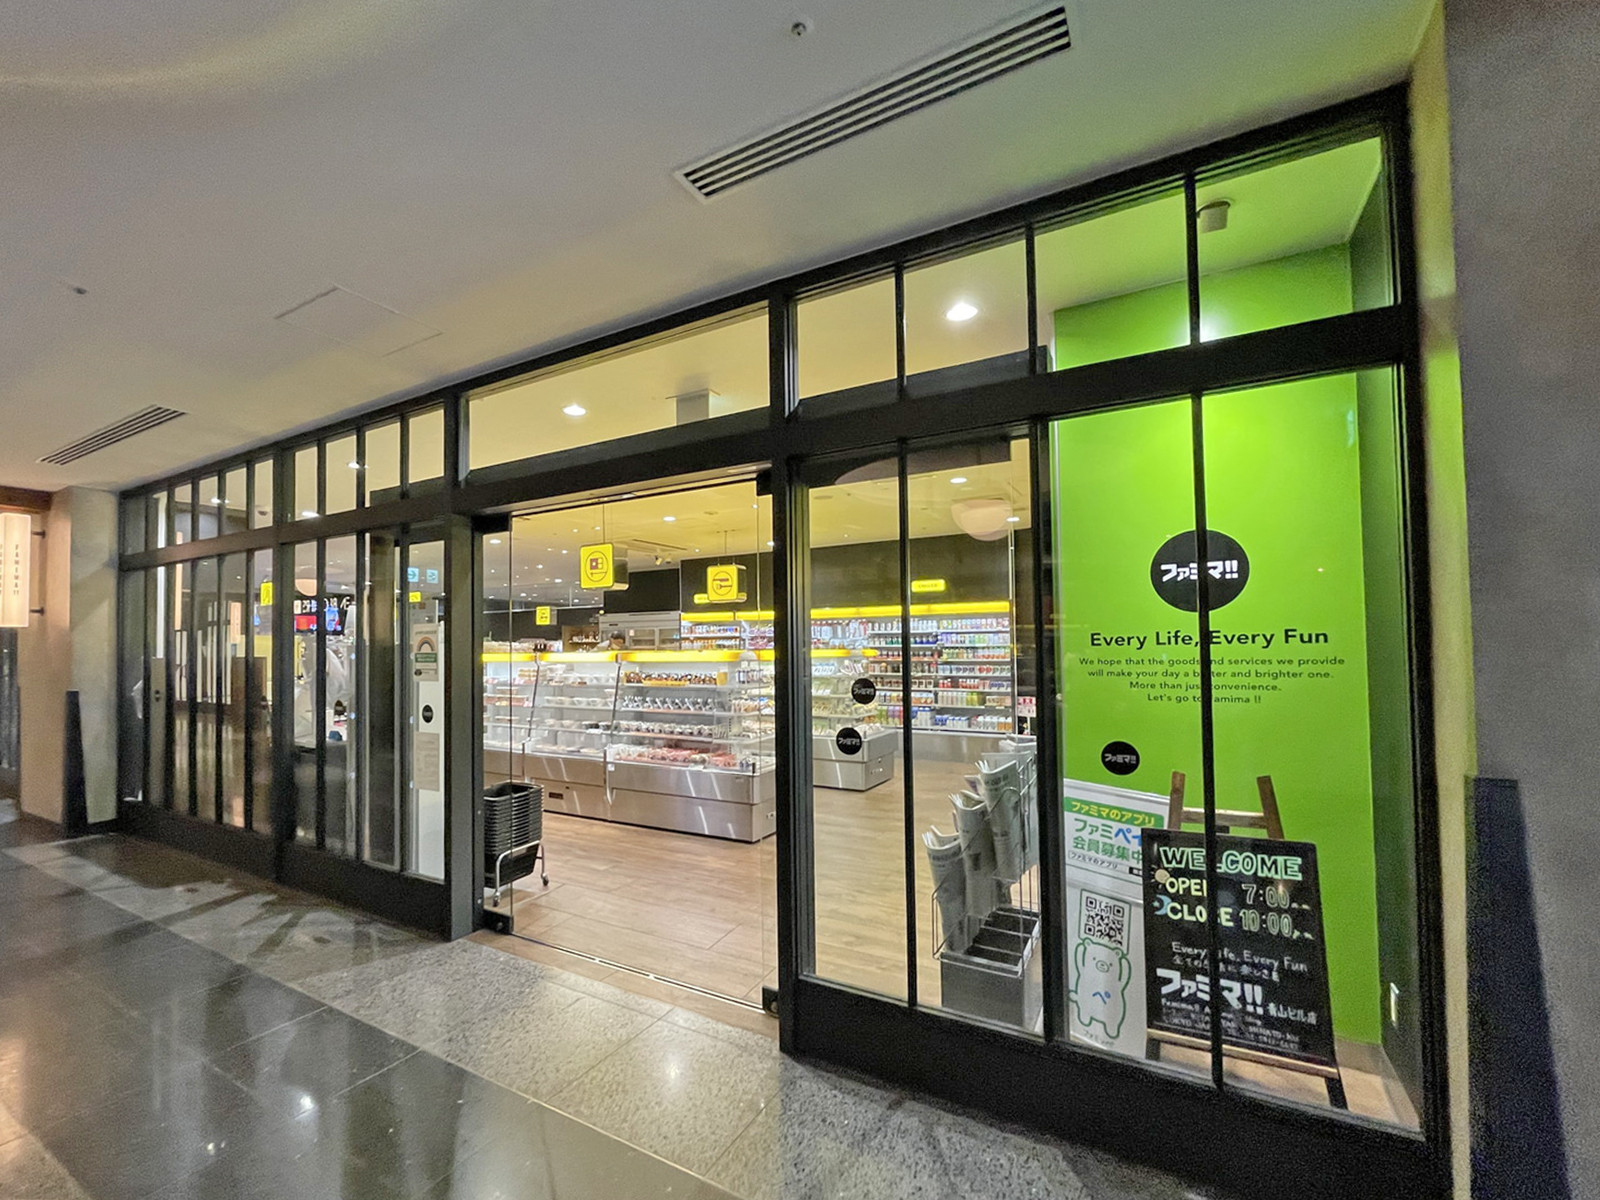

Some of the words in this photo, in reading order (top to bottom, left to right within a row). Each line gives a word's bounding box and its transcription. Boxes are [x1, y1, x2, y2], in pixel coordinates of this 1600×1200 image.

[1090, 631, 1147, 650] Every
[1155, 629, 1200, 648] Life,
[1209, 629, 1275, 649] Every
[1284, 628, 1328, 644] Fun
[1079, 657, 1095, 665] We
[1097, 657, 1122, 667] hope
[1125, 657, 1145, 665] that
[1148, 657, 1165, 665] the
[1167, 656, 1200, 667] goods
[1210, 656, 1224, 665] nd
[1228, 656, 1273, 666] services
[1297, 656, 1345, 668] provide
[1088, 669, 1104, 677] will
[1106, 669, 1133, 677] make
[1136, 670, 1158, 679] your
[1161, 669, 1180, 679] day
[1193, 668, 1227, 678] bter
[1230, 669, 1252, 678] and
[1255, 669, 1304, 681] brighter
[1307, 671, 1334, 679] one.
[1129, 681, 1156, 690] More
[1160, 681, 1183, 690] than
[1185, 681, 1200, 692] jus
[1211, 682, 1282, 692] onvenience.
[1147, 693, 1172, 702] Let's
[1175, 695, 1189, 703] go
[1213, 694, 1250, 704] amima
[1071, 801, 1155, 828] ファミマのアプリ
[1166, 902, 1234, 927] CLOE
[1171, 941, 1207, 961] Every
[1243, 950, 1280, 970] Every
[1284, 957, 1308, 973] Fun
[1092, 991, 1112, 1005] ペ
